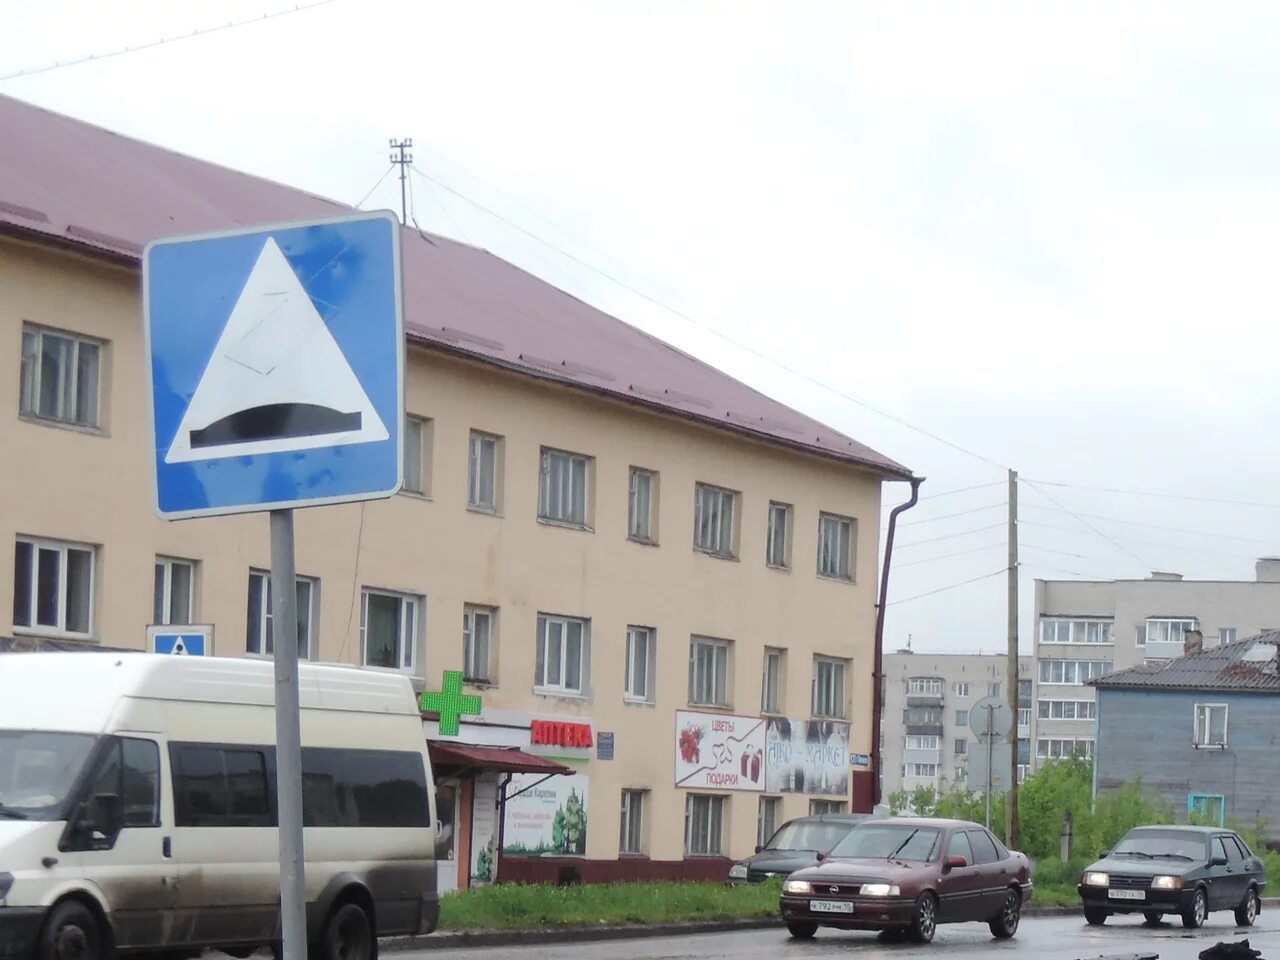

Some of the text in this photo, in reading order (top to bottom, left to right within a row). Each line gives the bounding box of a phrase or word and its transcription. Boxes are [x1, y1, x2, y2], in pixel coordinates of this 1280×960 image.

[530, 719, 594, 748] АПТЕКА
[711, 719, 735, 733] ЦВЕТЫ
[706, 772, 739, 787] ПОДАРКИ
